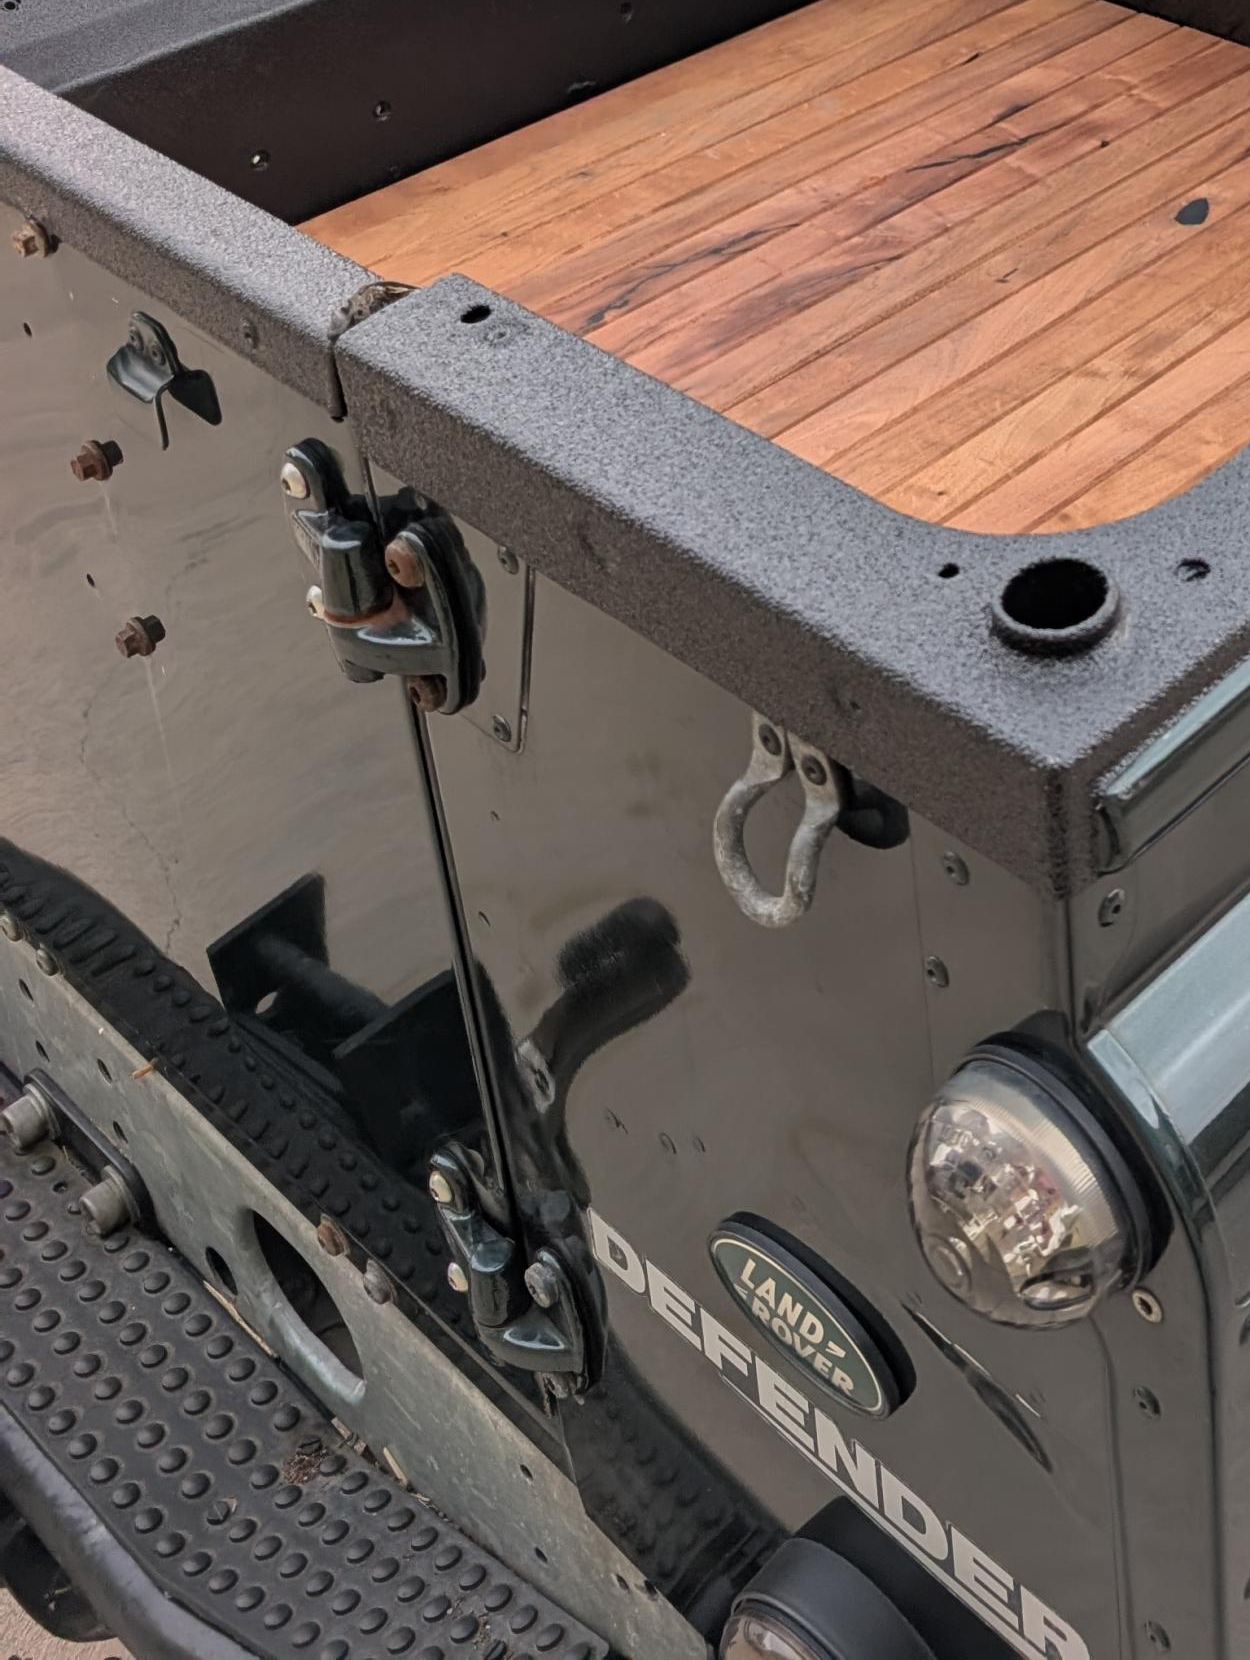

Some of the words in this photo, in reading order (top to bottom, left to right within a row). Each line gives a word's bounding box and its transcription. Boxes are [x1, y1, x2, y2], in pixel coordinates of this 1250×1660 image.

[741, 1258, 825, 1344] LAND
[751, 1296, 855, 1397] ROVER
[588, 1208, 1090, 1660] DEFENDER
